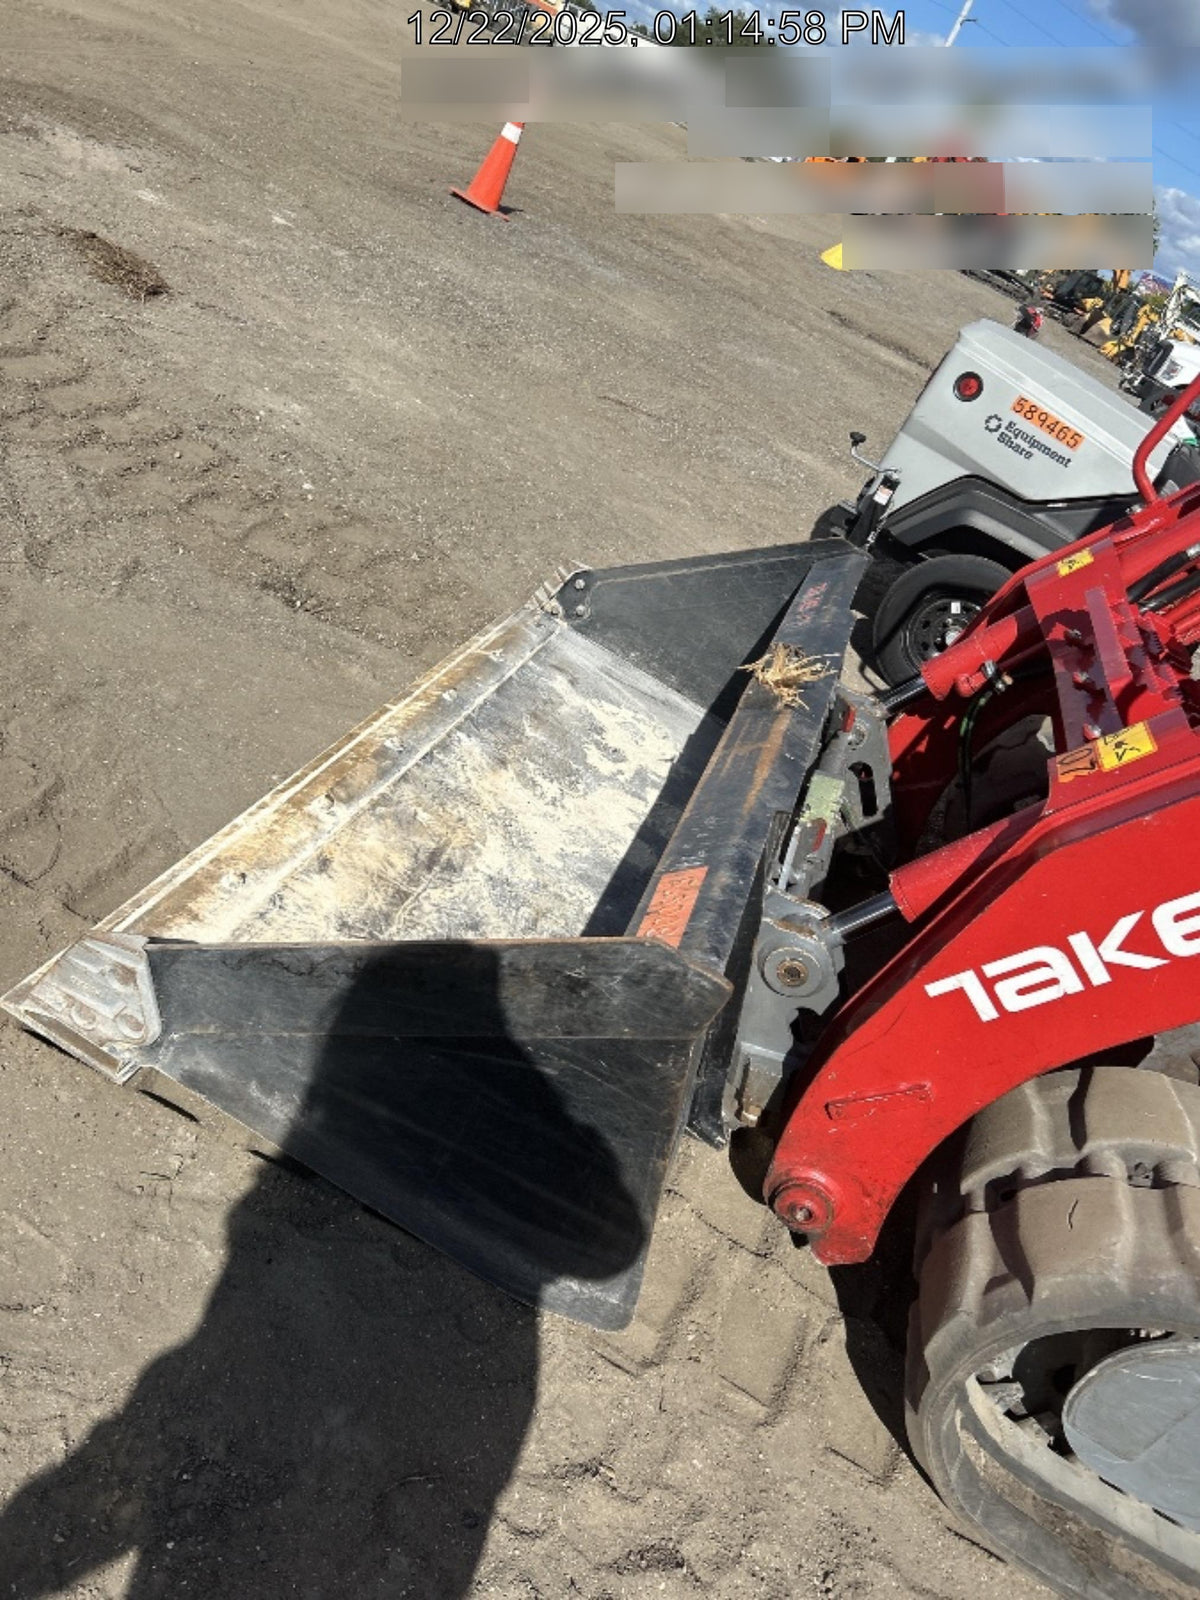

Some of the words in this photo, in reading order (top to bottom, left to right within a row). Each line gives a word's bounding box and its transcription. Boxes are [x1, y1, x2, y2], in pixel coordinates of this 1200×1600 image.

[997, 431, 1034, 460] Share
[1004, 420, 1072, 468] Equipment
[1012, 397, 1082, 449] 589465
